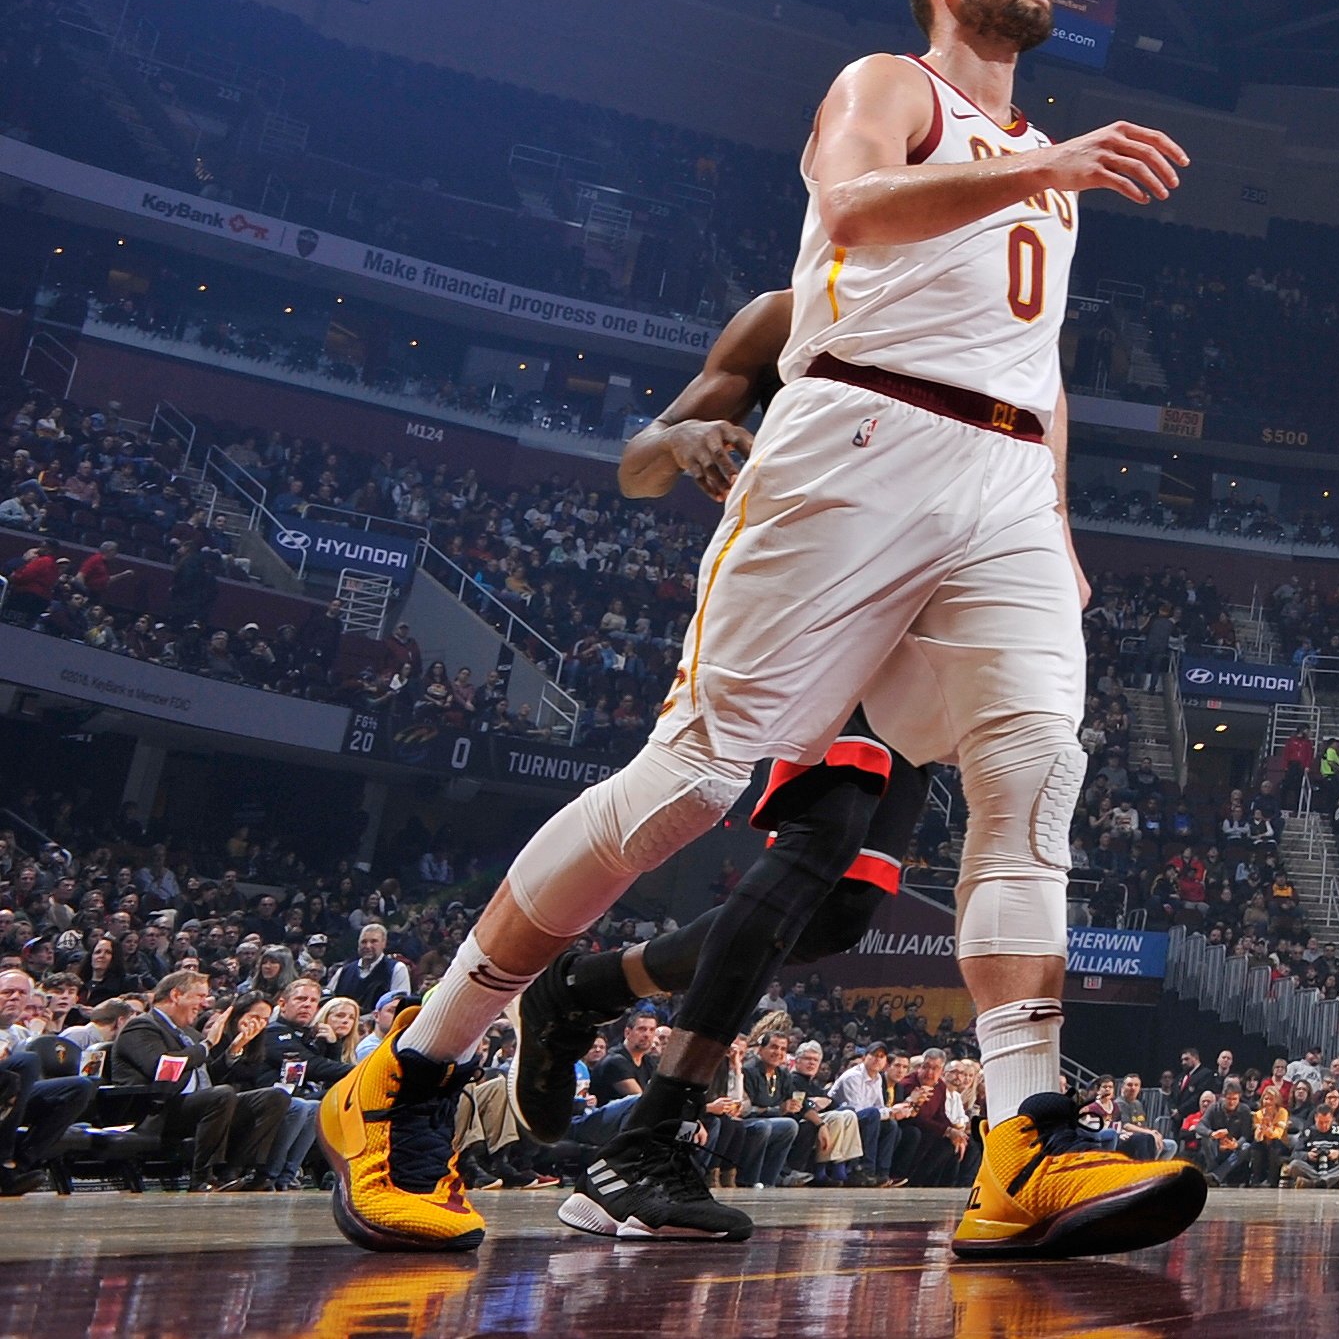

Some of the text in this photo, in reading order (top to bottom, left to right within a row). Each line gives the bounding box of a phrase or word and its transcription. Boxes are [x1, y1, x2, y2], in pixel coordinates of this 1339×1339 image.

[142, 193, 225, 229] KeyBank
[1008, 222, 1046, 323] 0
[363, 249, 710, 349] Make financial progress one bucket
[406, 422, 444, 443] M124
[1262, 428, 1308, 447] $500
[316, 538, 408, 568] HYUNDAI
[1218, 672, 1294, 691] HYUNDAI
[350, 731, 375, 753] 20
[451, 737, 472, 769] 0
